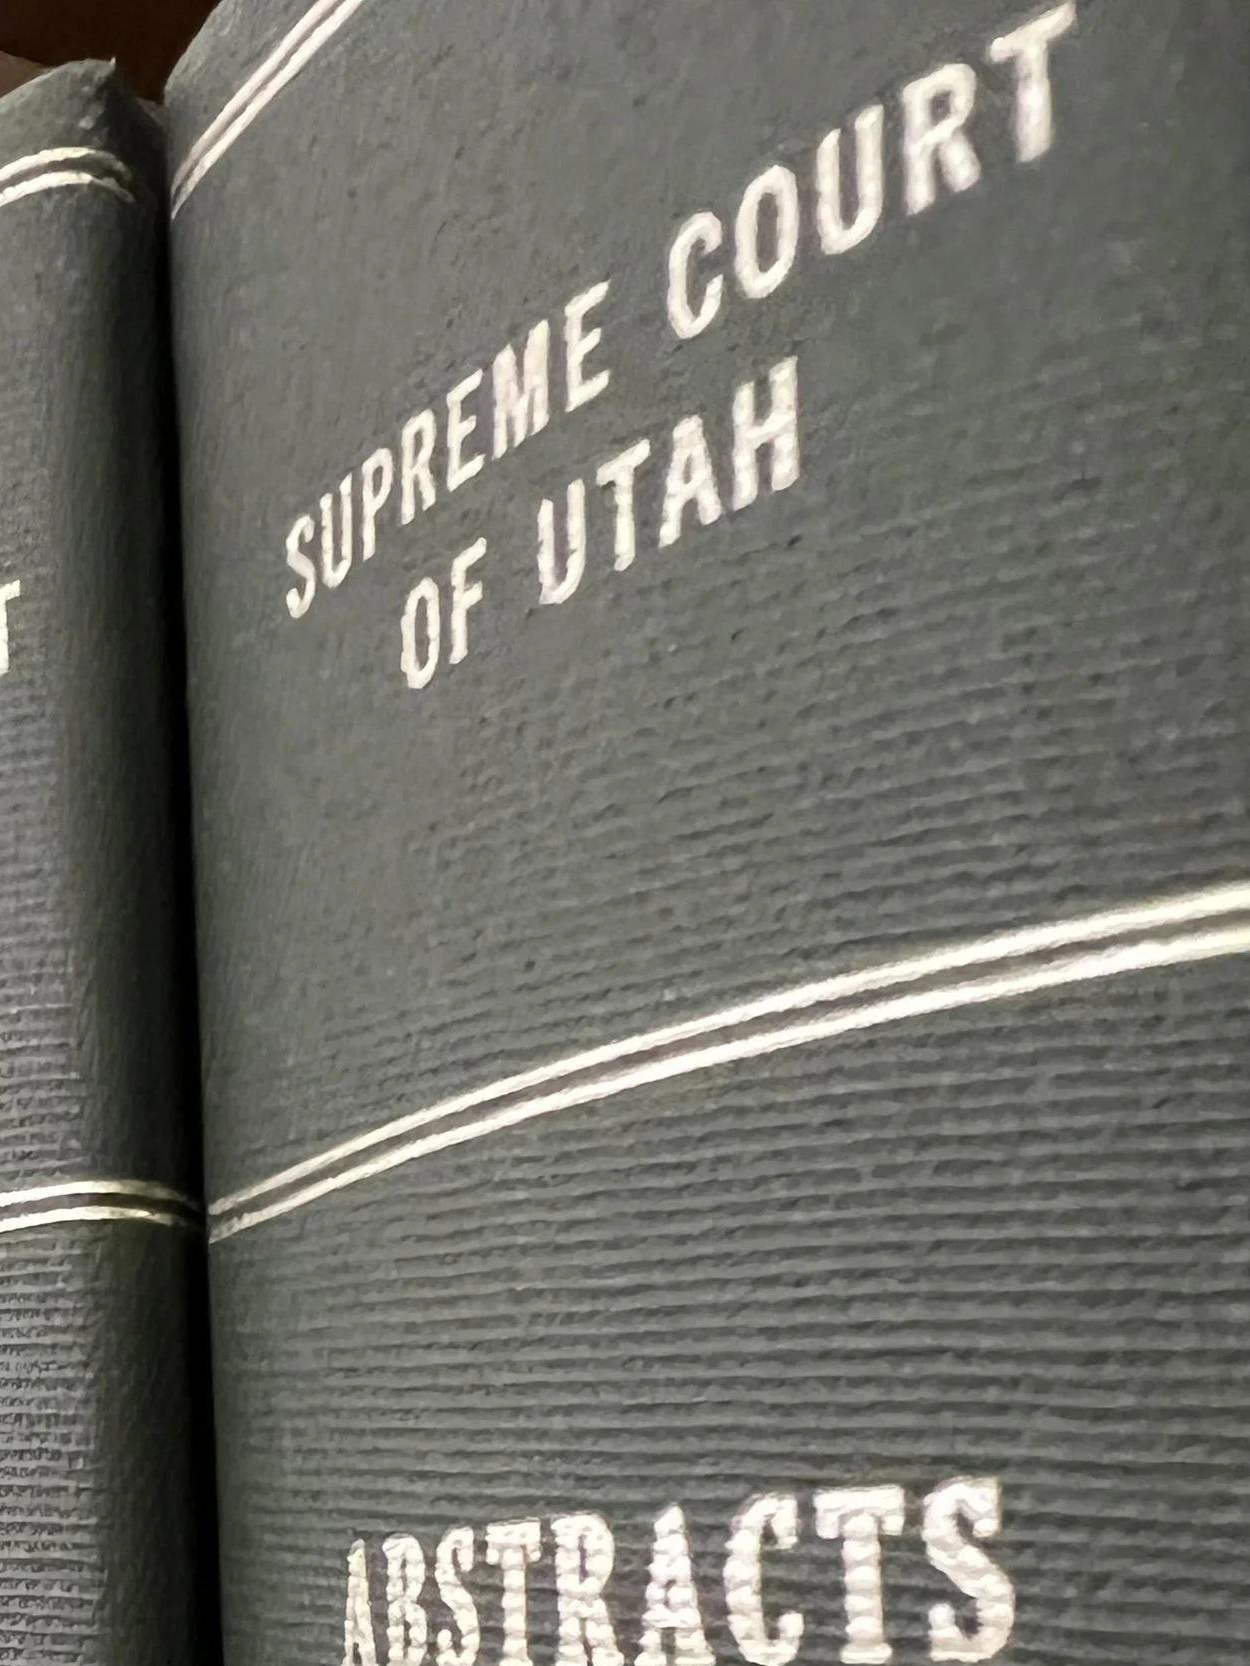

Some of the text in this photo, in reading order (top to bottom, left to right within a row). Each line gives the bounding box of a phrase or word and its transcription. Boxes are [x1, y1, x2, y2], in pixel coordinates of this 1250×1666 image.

[285, 2, 1077, 619] SUPREME COURT
[400, 356, 799, 690] OF UTAH
